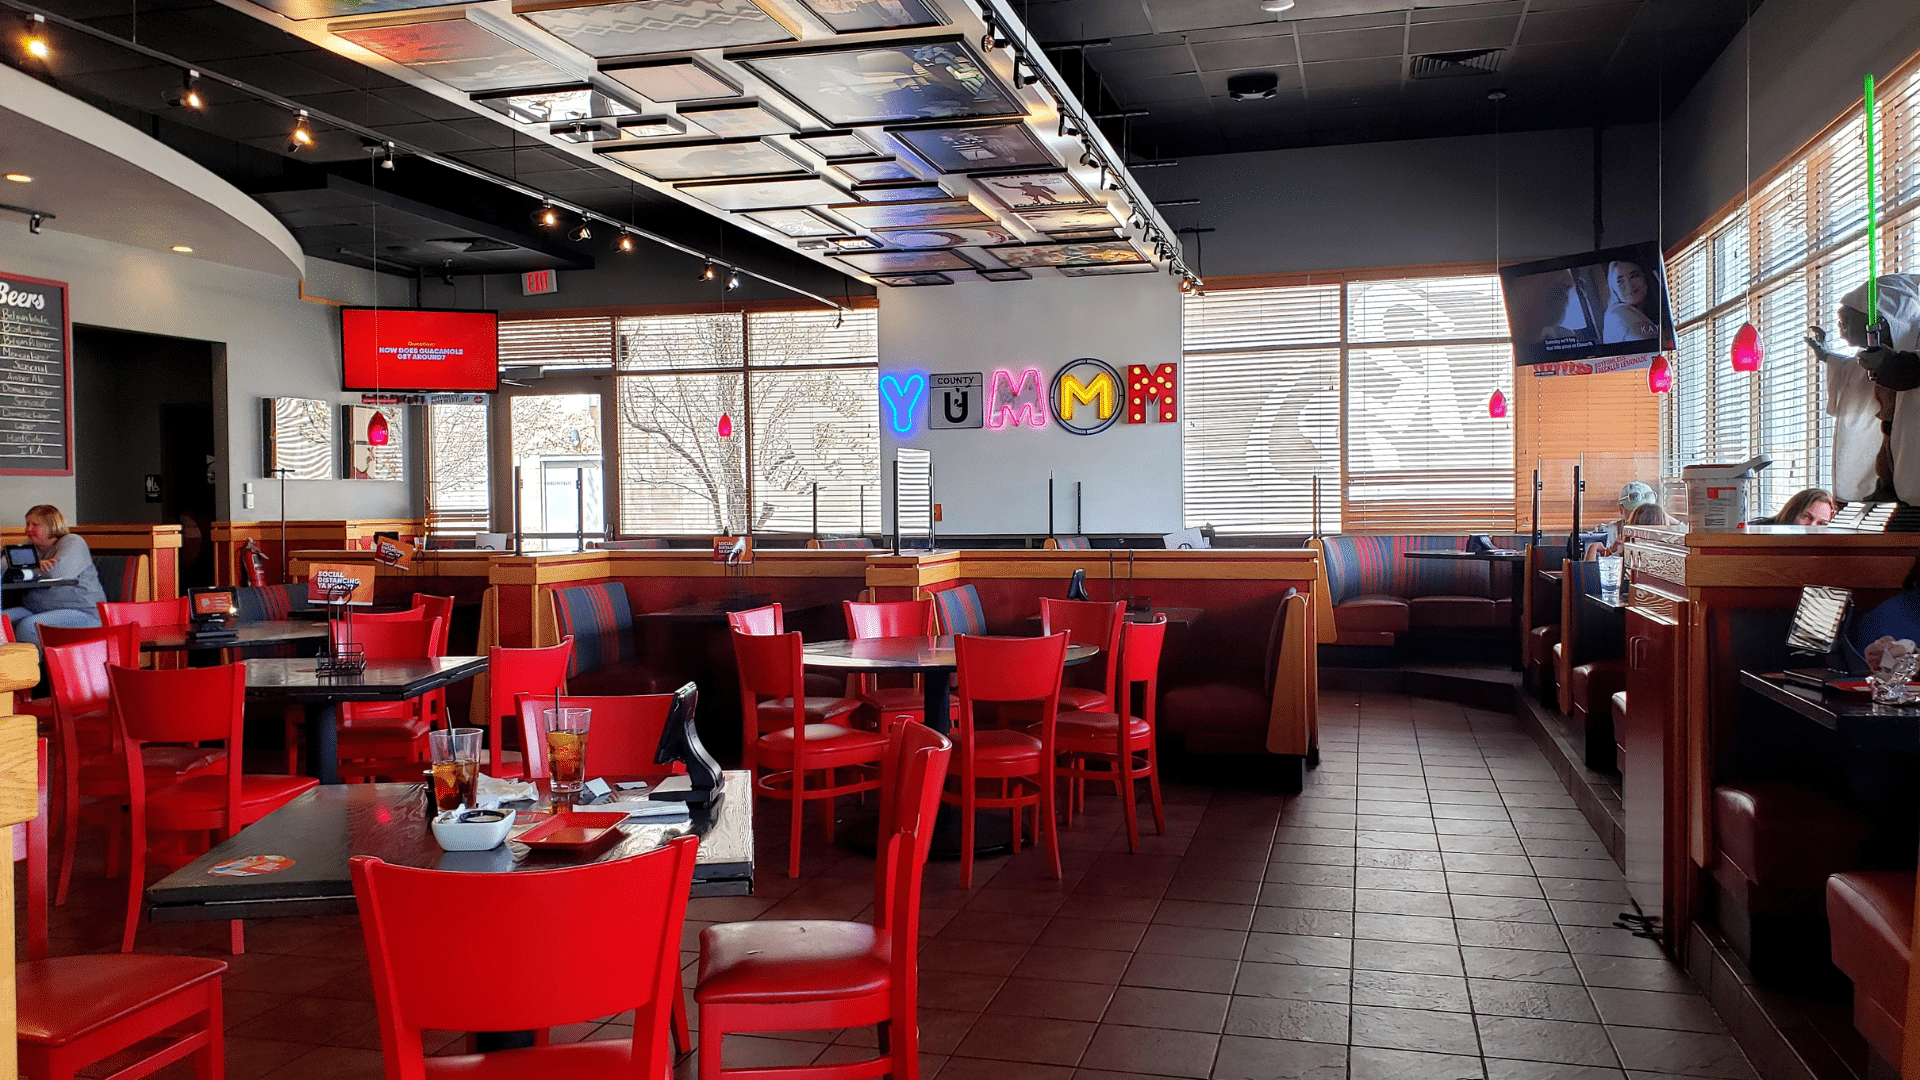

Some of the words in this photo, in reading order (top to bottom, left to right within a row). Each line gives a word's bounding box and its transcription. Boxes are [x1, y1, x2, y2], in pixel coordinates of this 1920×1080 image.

[527, 270, 548, 292] EXIT
[0, 281, 45, 310] Beers
[398, 347, 418, 355] DOES
[419, 348, 464, 356] GUACAMOLE
[937, 376, 974, 385] COUNTY
